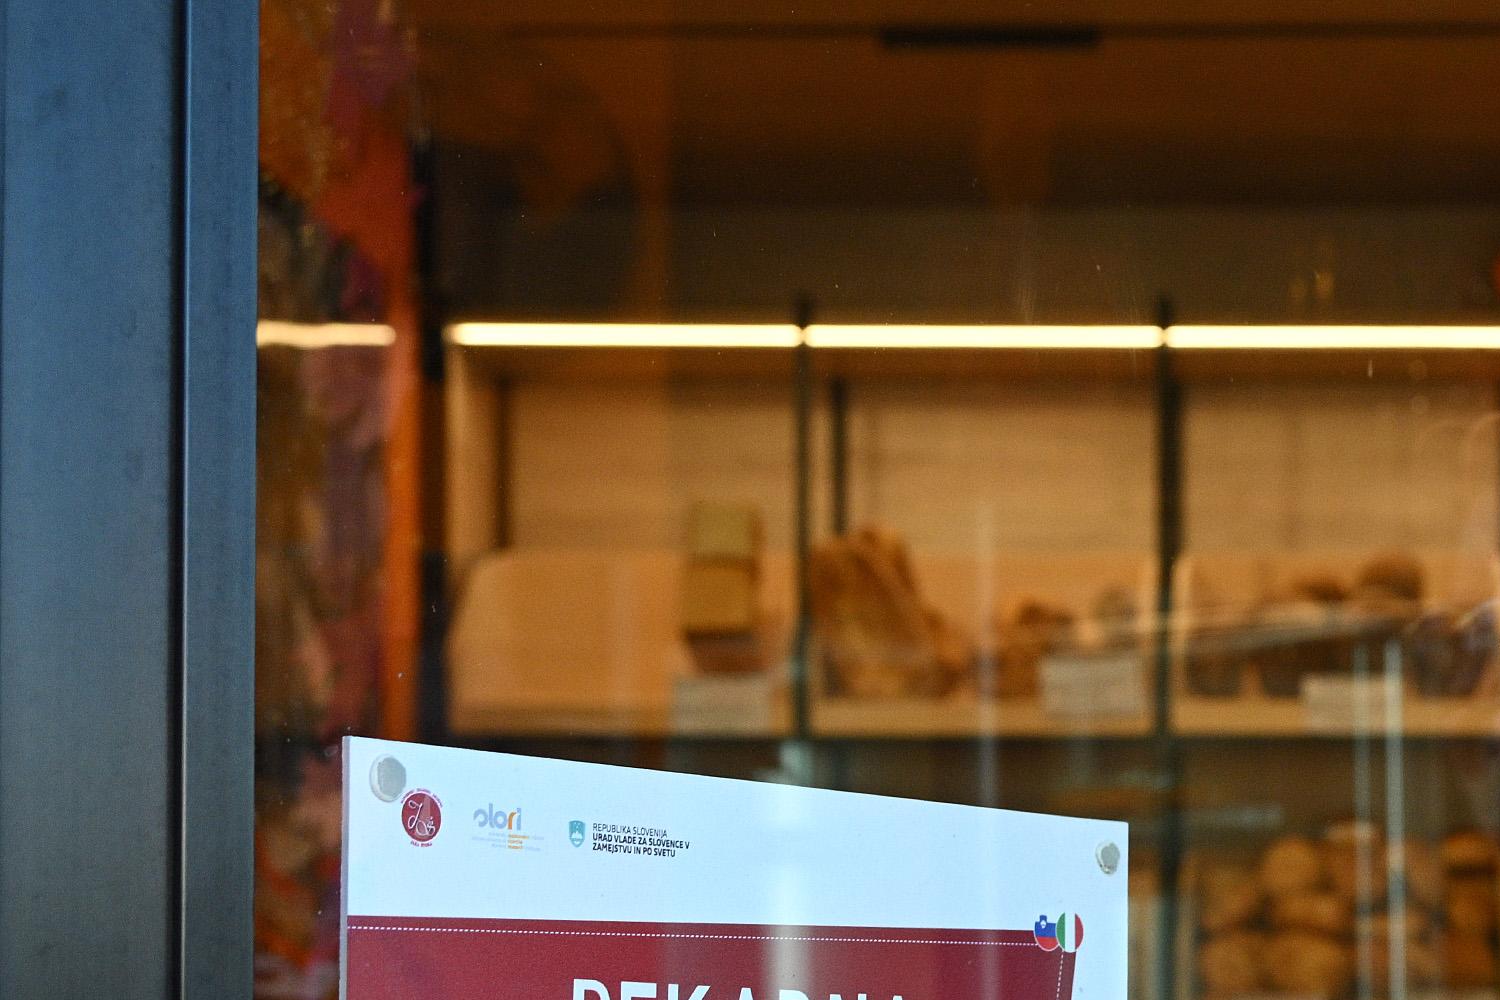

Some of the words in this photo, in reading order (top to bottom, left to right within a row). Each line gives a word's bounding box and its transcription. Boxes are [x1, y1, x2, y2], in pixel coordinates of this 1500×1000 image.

[592, 823, 631, 834] REPUBLIKA
[633, 827, 667, 838] SLOVENIJA
[592, 833, 612, 842] URAD
[614, 835, 636, 844] VLADE
[638, 837, 647, 845] ZA
[649, 838, 684, 849] SLOVENCE
[685, 841, 690, 849] V
[592, 843, 632, 854] ZAMEJSTVU
[634, 846, 641, 854] IN
[643, 847, 652, 855] PO
[654, 848, 676, 857] SVETU
